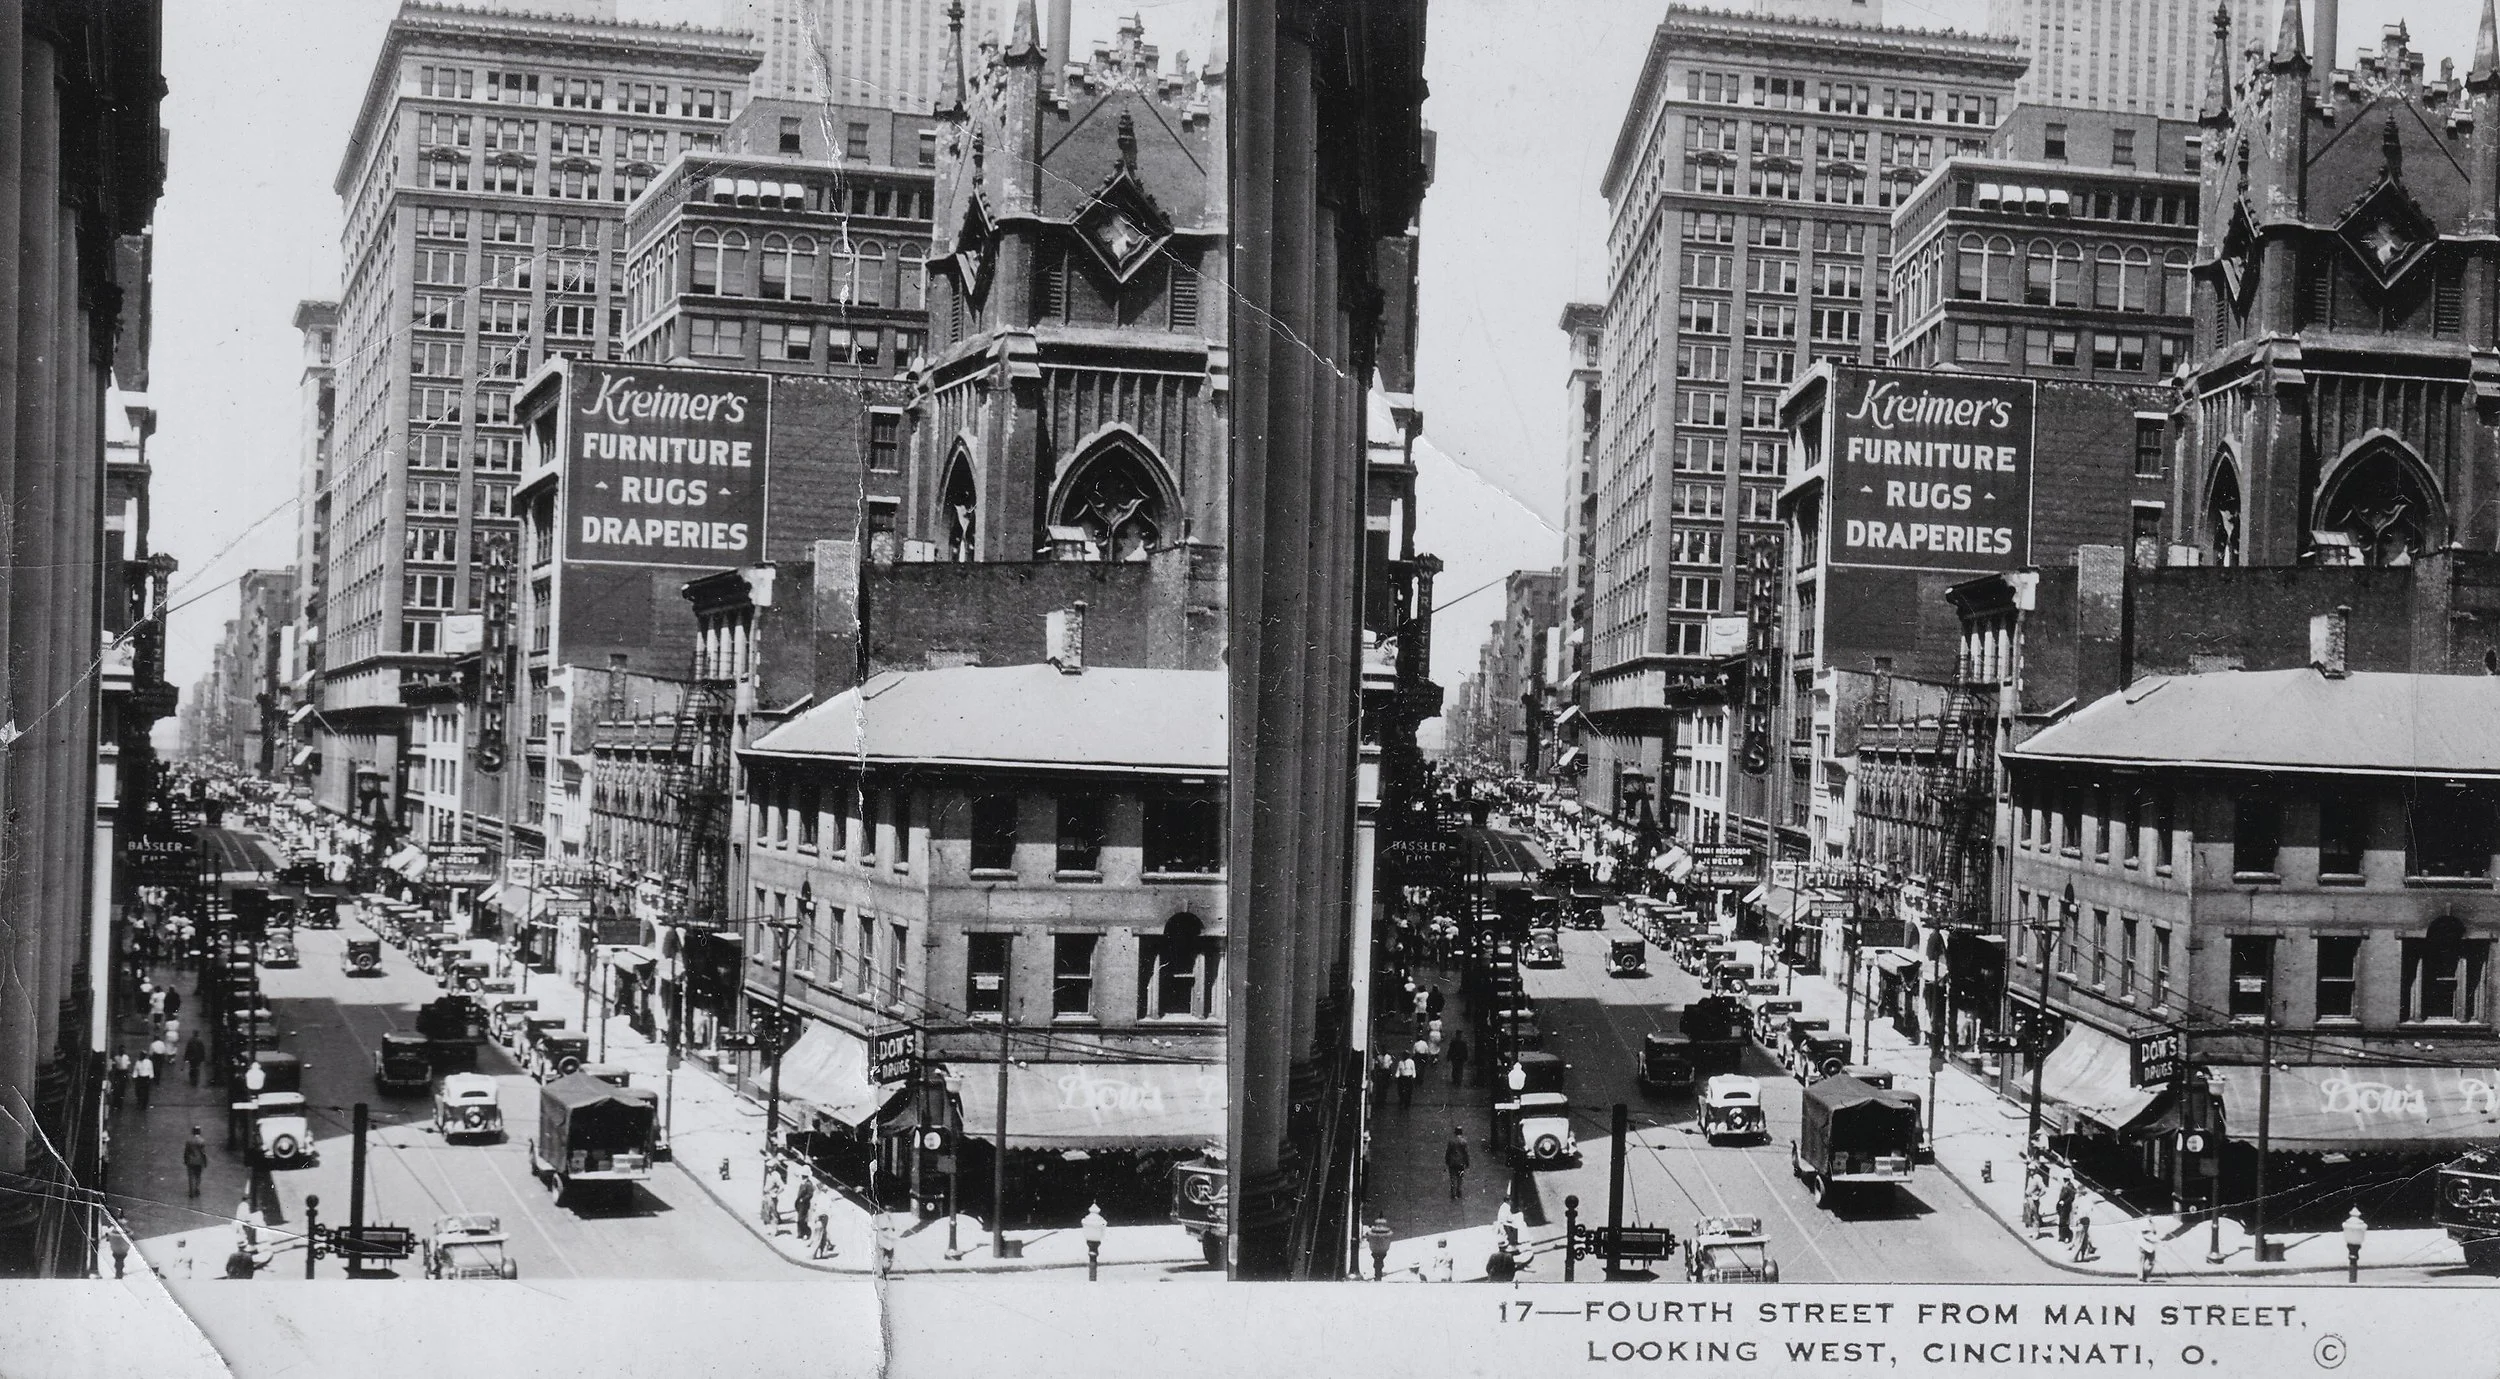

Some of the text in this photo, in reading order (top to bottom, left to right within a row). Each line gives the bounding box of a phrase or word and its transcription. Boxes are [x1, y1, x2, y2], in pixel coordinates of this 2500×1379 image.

[581, 371, 749, 425] Kreimer's
[1846, 378, 2013, 430] Kreimer's
[582, 432, 753, 468] FURNITURE
[1846, 437, 2017, 473] FURNITURE
[620, 475, 709, 507] RUGS
[1885, 480, 1973, 511] RUGS
[581, 516, 749, 551] DRAPERIES
[1845, 519, 2013, 555] DRAPERIES
